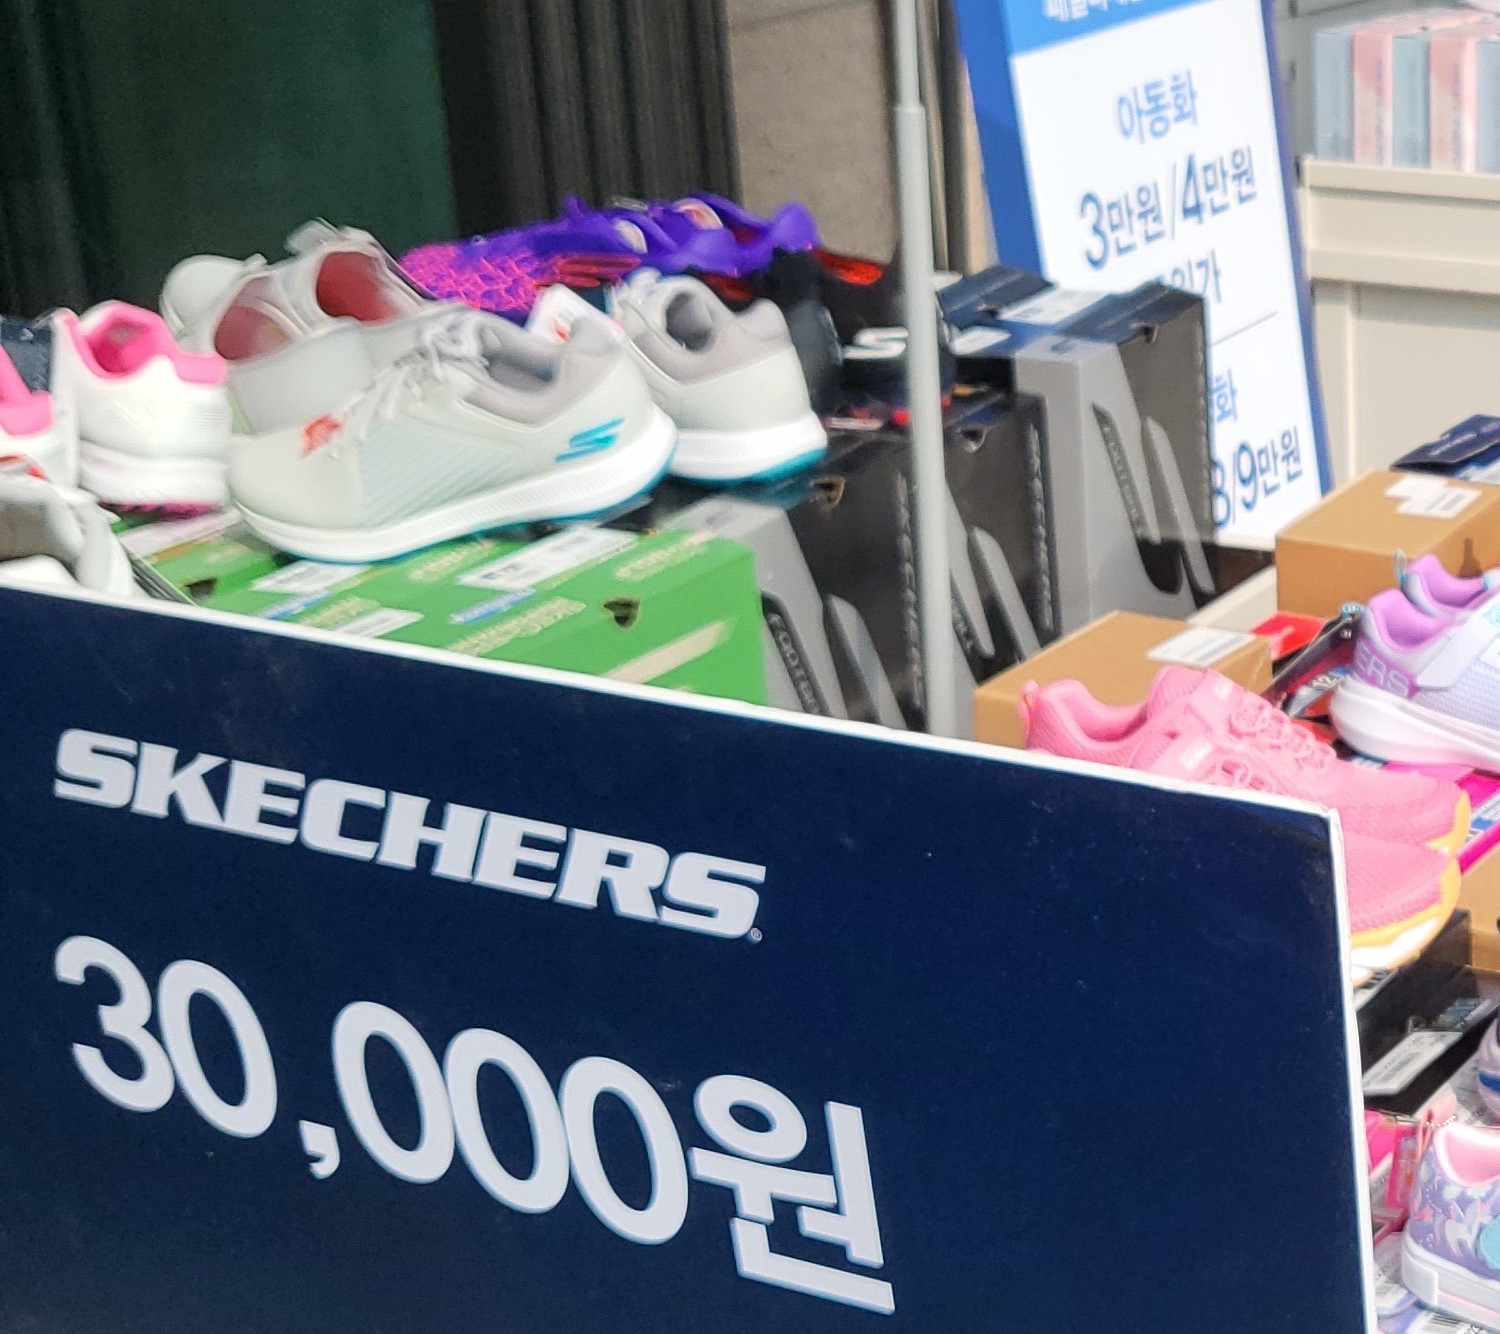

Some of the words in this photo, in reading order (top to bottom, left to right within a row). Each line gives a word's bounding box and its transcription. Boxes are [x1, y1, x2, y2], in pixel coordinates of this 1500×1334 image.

[1117, 69, 1198, 144] 아동화
[53, 728, 767, 941] SKECHERS
[54, 935, 896, 1315] 30,000원
